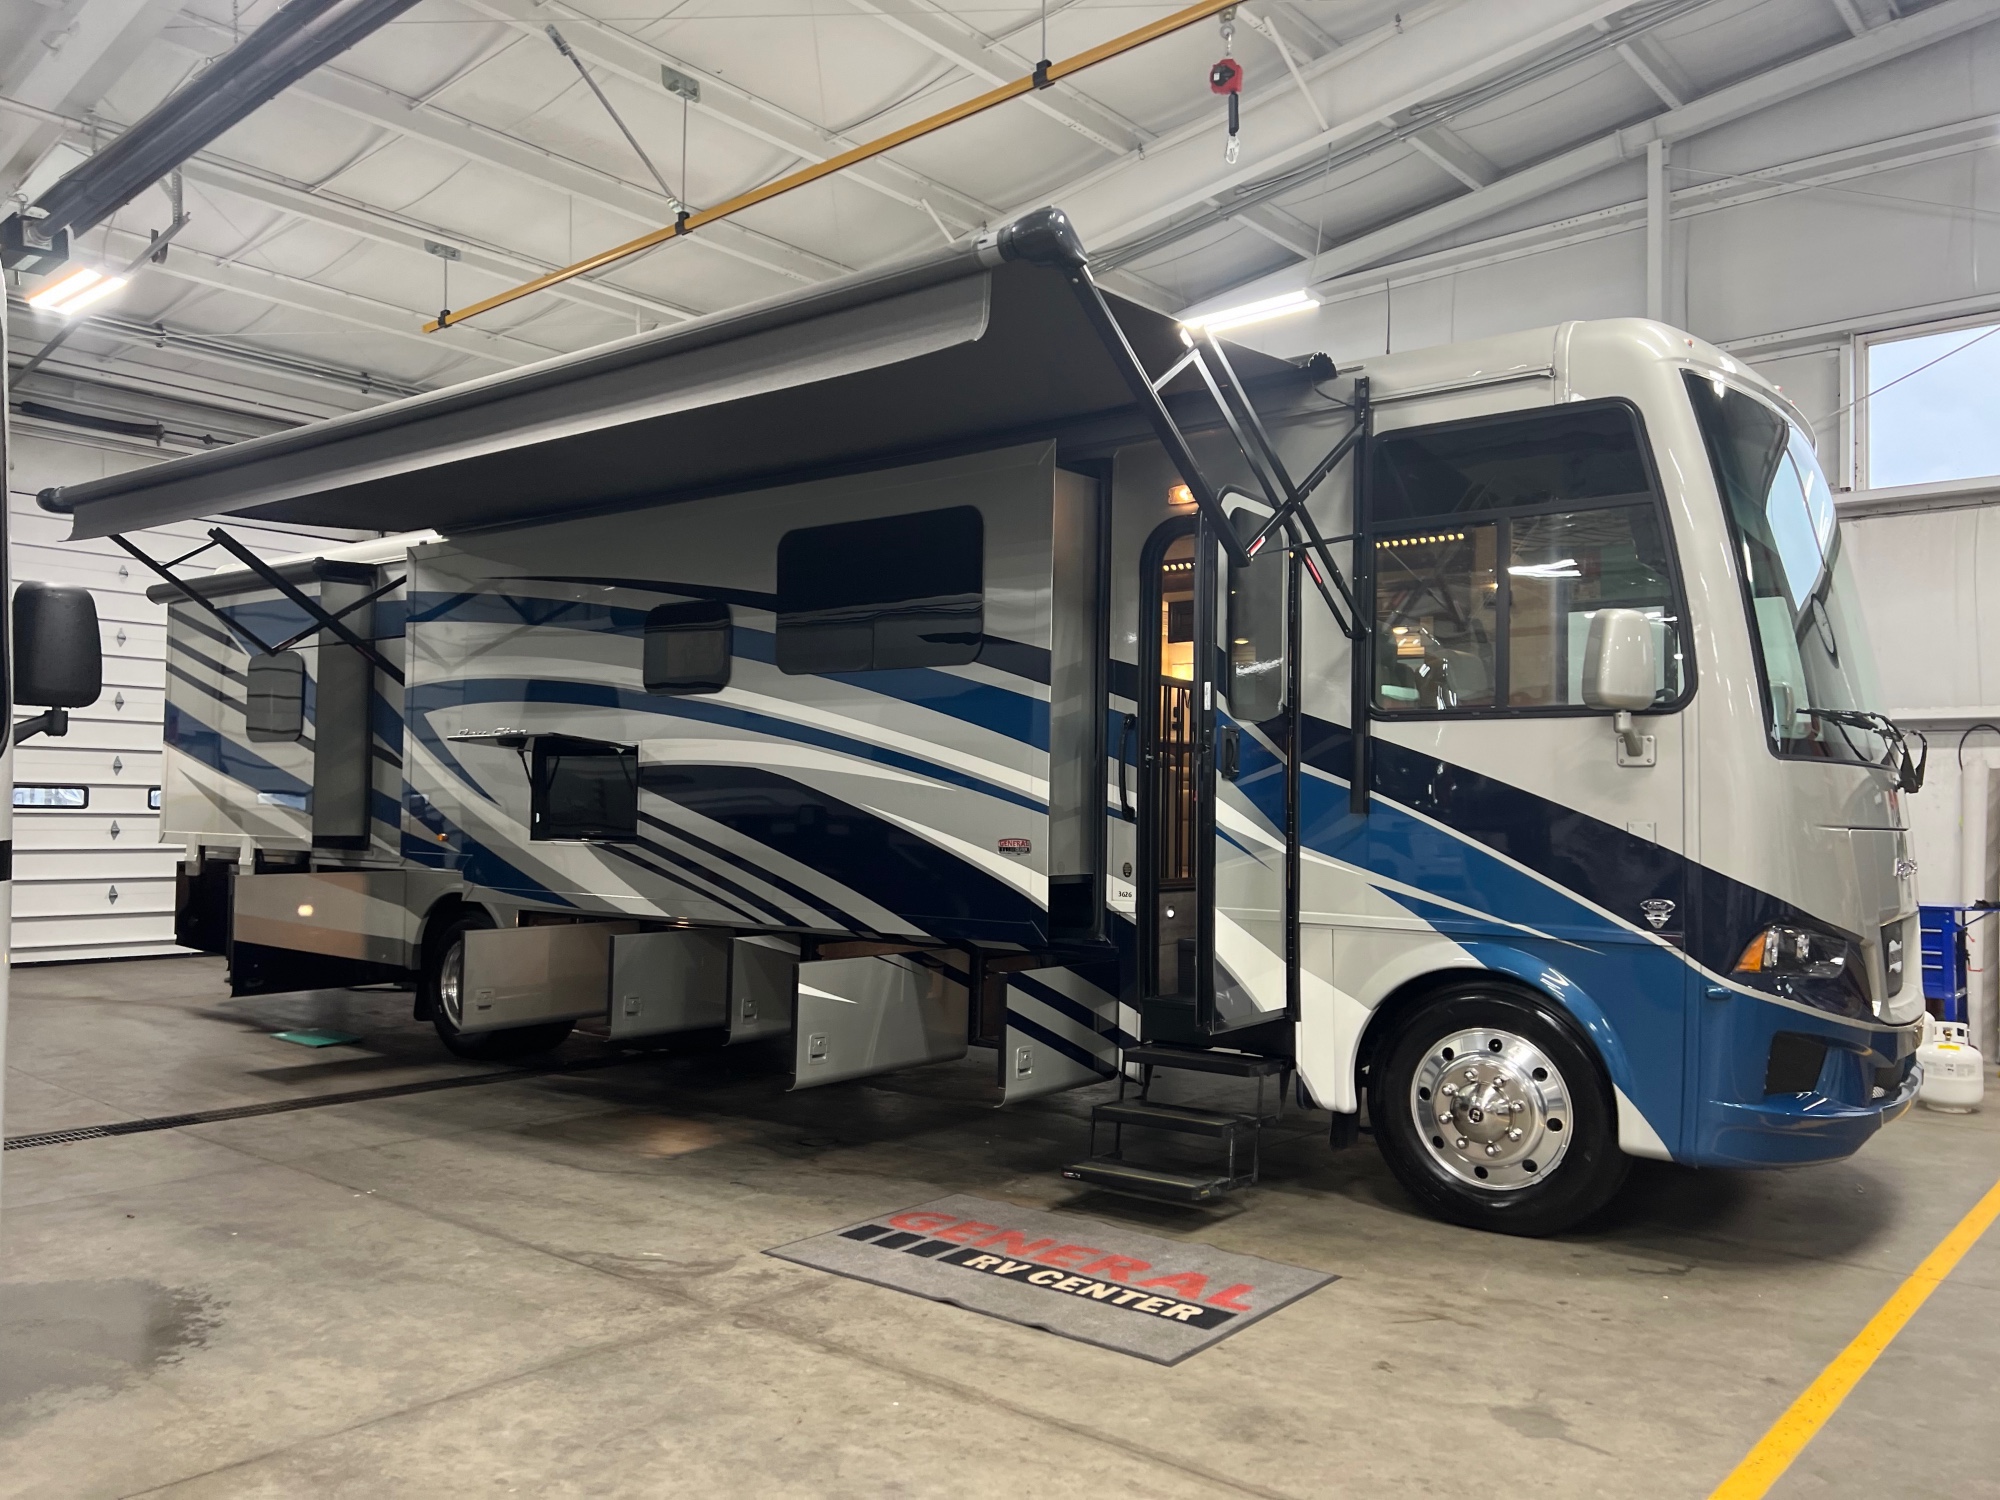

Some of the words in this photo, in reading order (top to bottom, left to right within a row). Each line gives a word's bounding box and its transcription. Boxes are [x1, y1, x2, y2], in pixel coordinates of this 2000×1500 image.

[1118, 890, 1133, 898] 3626
[888, 1212, 1255, 1312] GENERAL
[962, 1254, 1032, 1275] RV
[1027, 1270, 1204, 1321] CENTER
